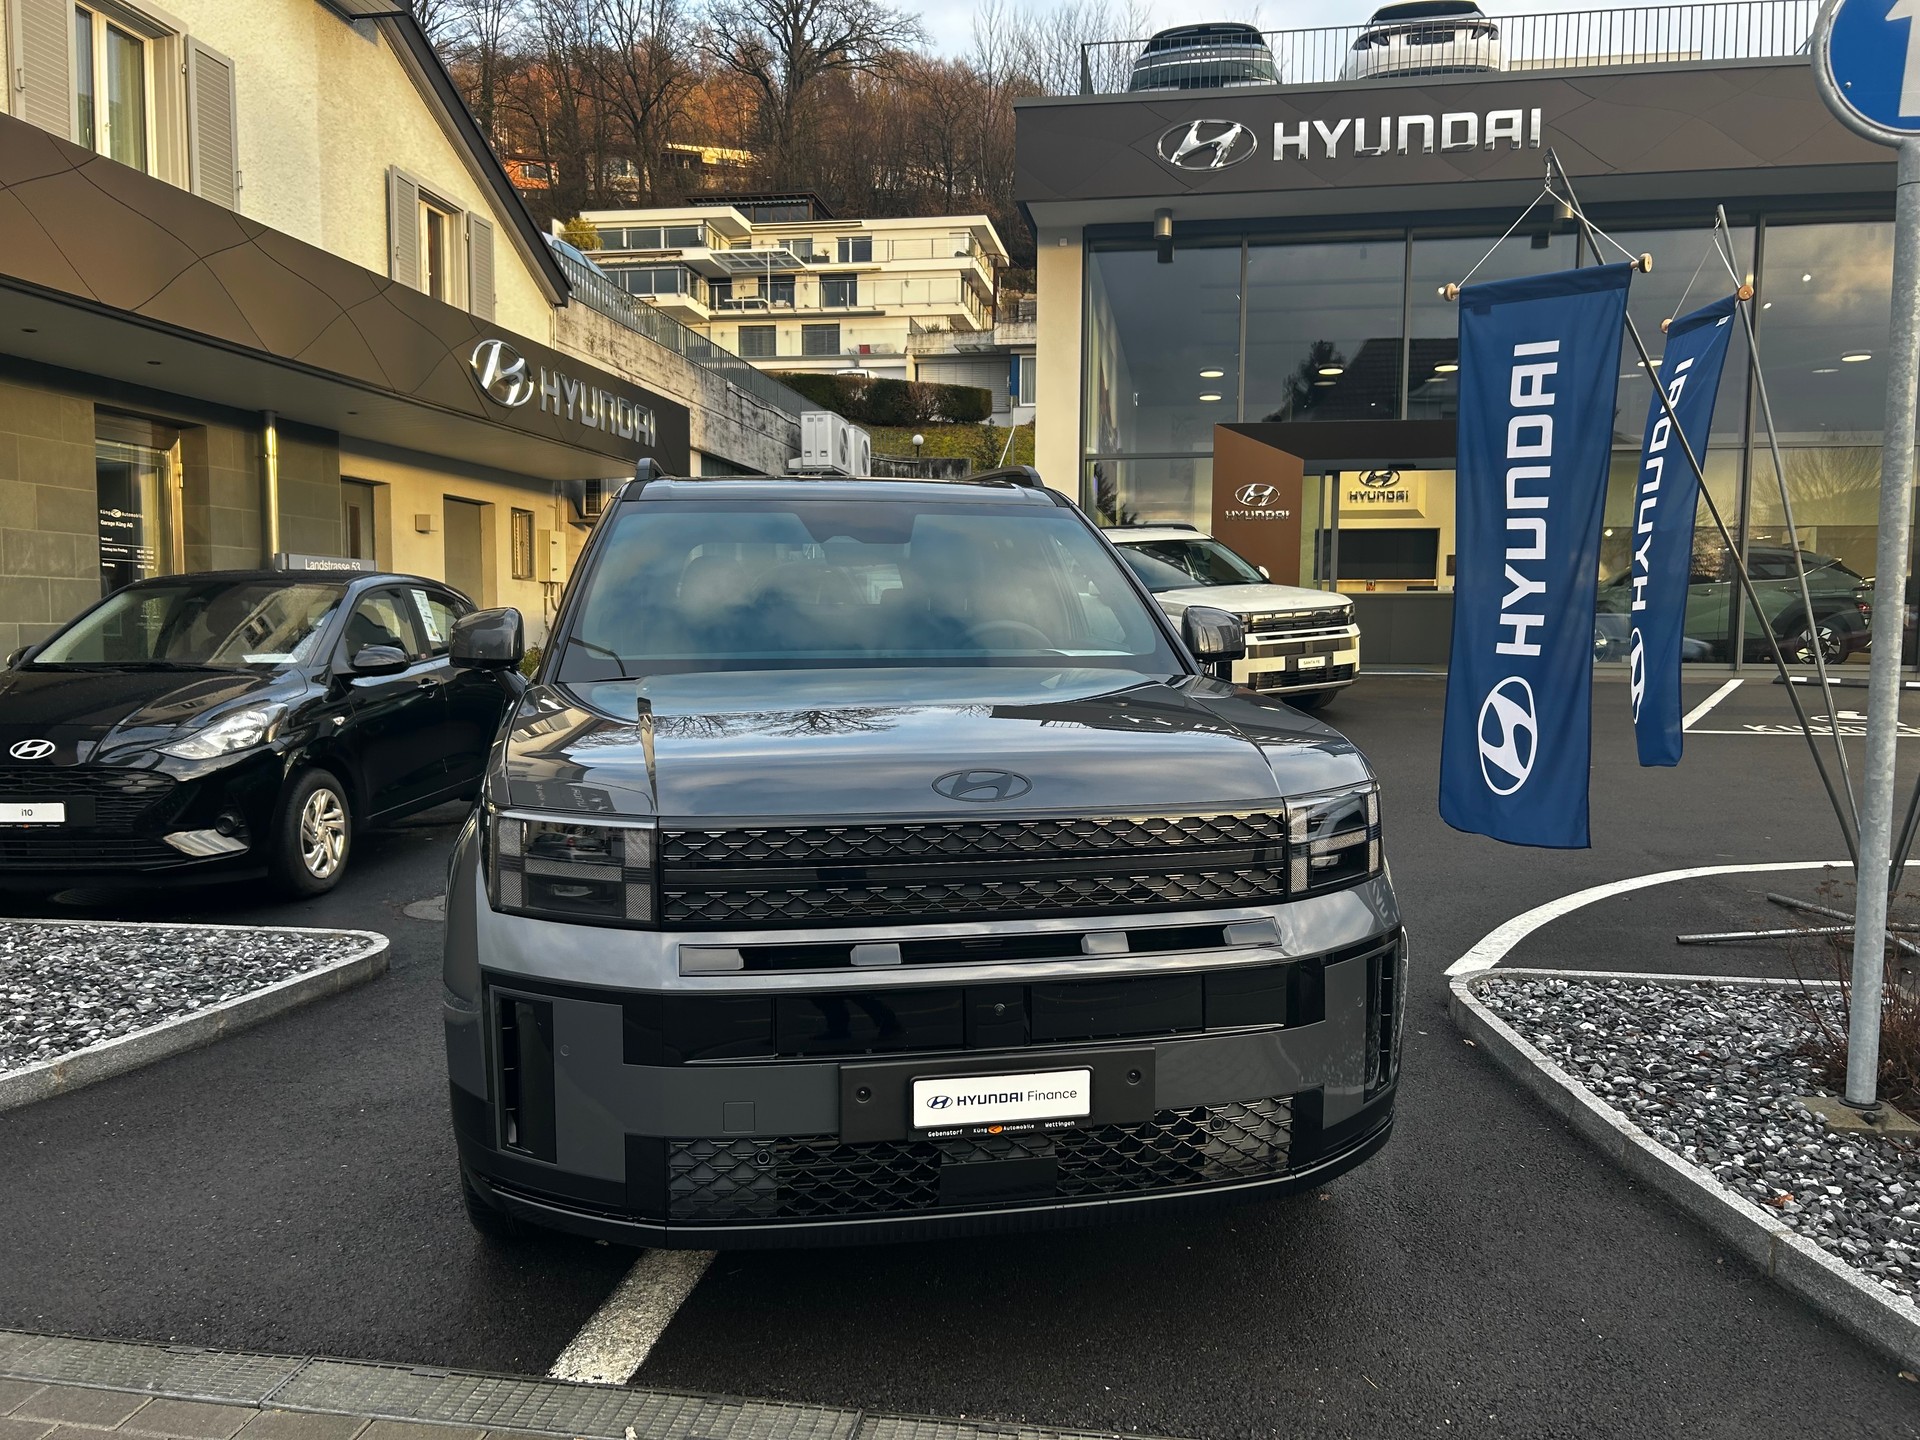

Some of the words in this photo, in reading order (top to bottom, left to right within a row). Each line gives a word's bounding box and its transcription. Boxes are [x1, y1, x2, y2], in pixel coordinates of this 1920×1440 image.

[1273, 108, 1542, 162] HYUNDAI
[540, 366, 656, 448] HYUNDAI
[1349, 490, 1409, 503] HYUNDAI
[1495, 340, 1560, 657] HYUNDAI
[1225, 510, 1290, 521] HYUNDAI
[305, 558, 350, 571] Landstrasse
[351, 561, 361, 571] 53
[21, 808, 33, 817] i10
[957, 1092, 1023, 1107] HYUNDAI
[1027, 1090, 1078, 1102] Finance
[928, 1129, 963, 1138] Gebenstorf
[1003, 1123, 1035, 1132] Automobile
[1045, 1120, 1075, 1129] Wettingen
